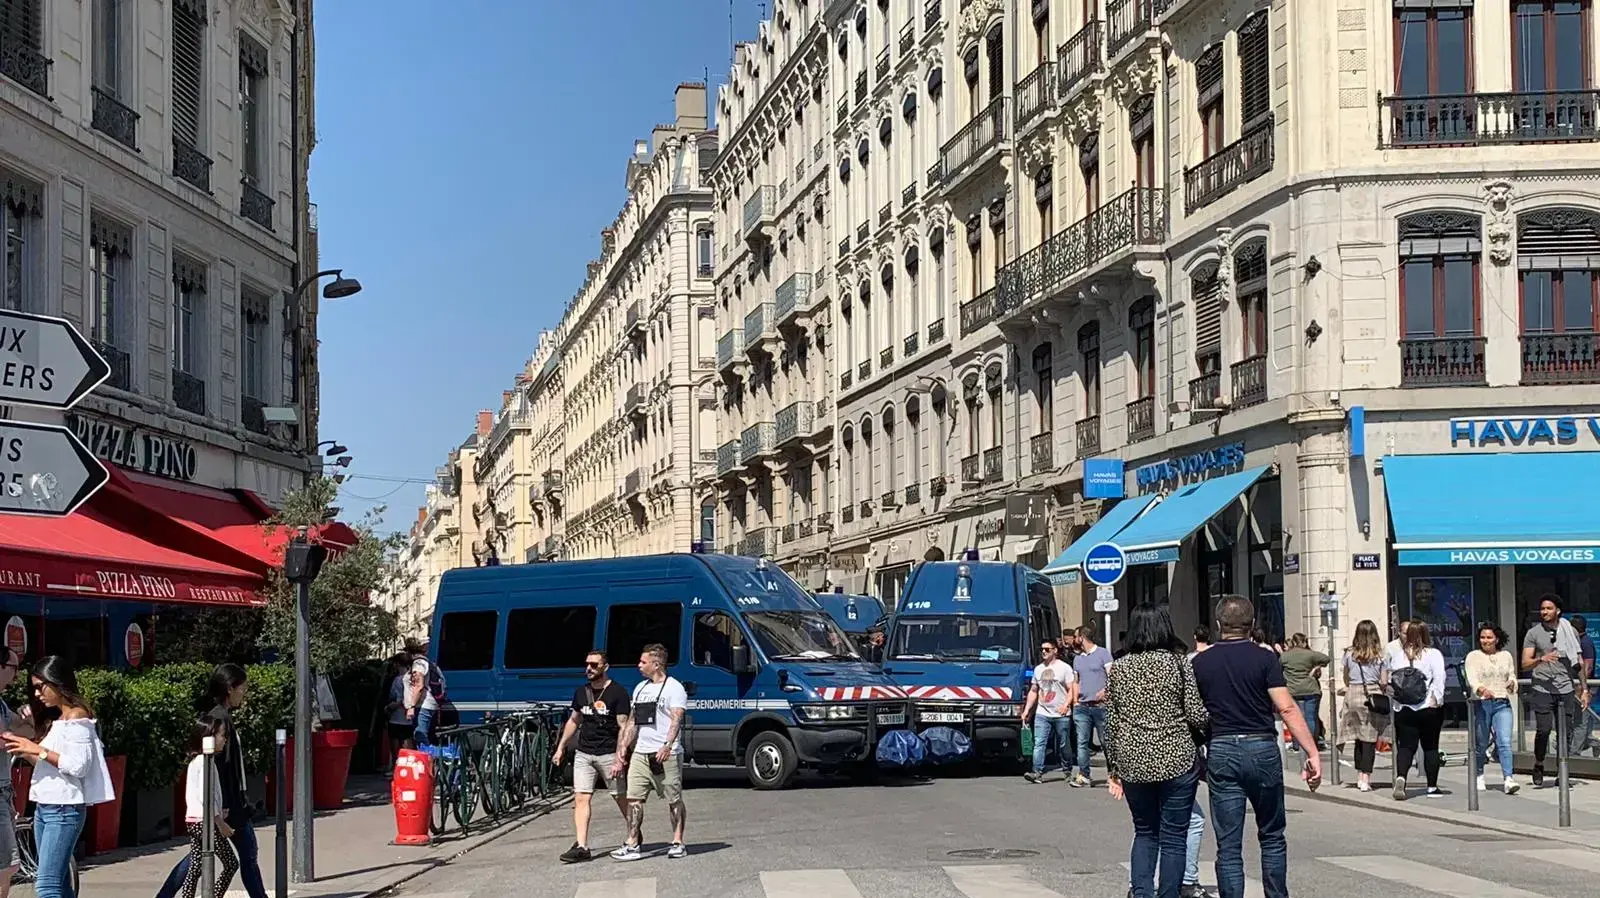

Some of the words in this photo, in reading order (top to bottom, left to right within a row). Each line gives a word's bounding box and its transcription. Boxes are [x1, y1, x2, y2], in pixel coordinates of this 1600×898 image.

[1451, 417, 1578, 442] HAVAS
[149, 435, 197, 480] PINO
[1130, 550, 1159, 562] VOYAGES
[1450, 550, 1510, 562] HAVAS
[1513, 549, 1595, 561] VOYAGES
[96, 570, 142, 595] PIZZA
[140, 575, 176, 598] PINO
[767, 581, 778, 591] A1
[189, 587, 245, 603] RESTAURANT
[695, 699, 746, 710] GENDARMERIE
